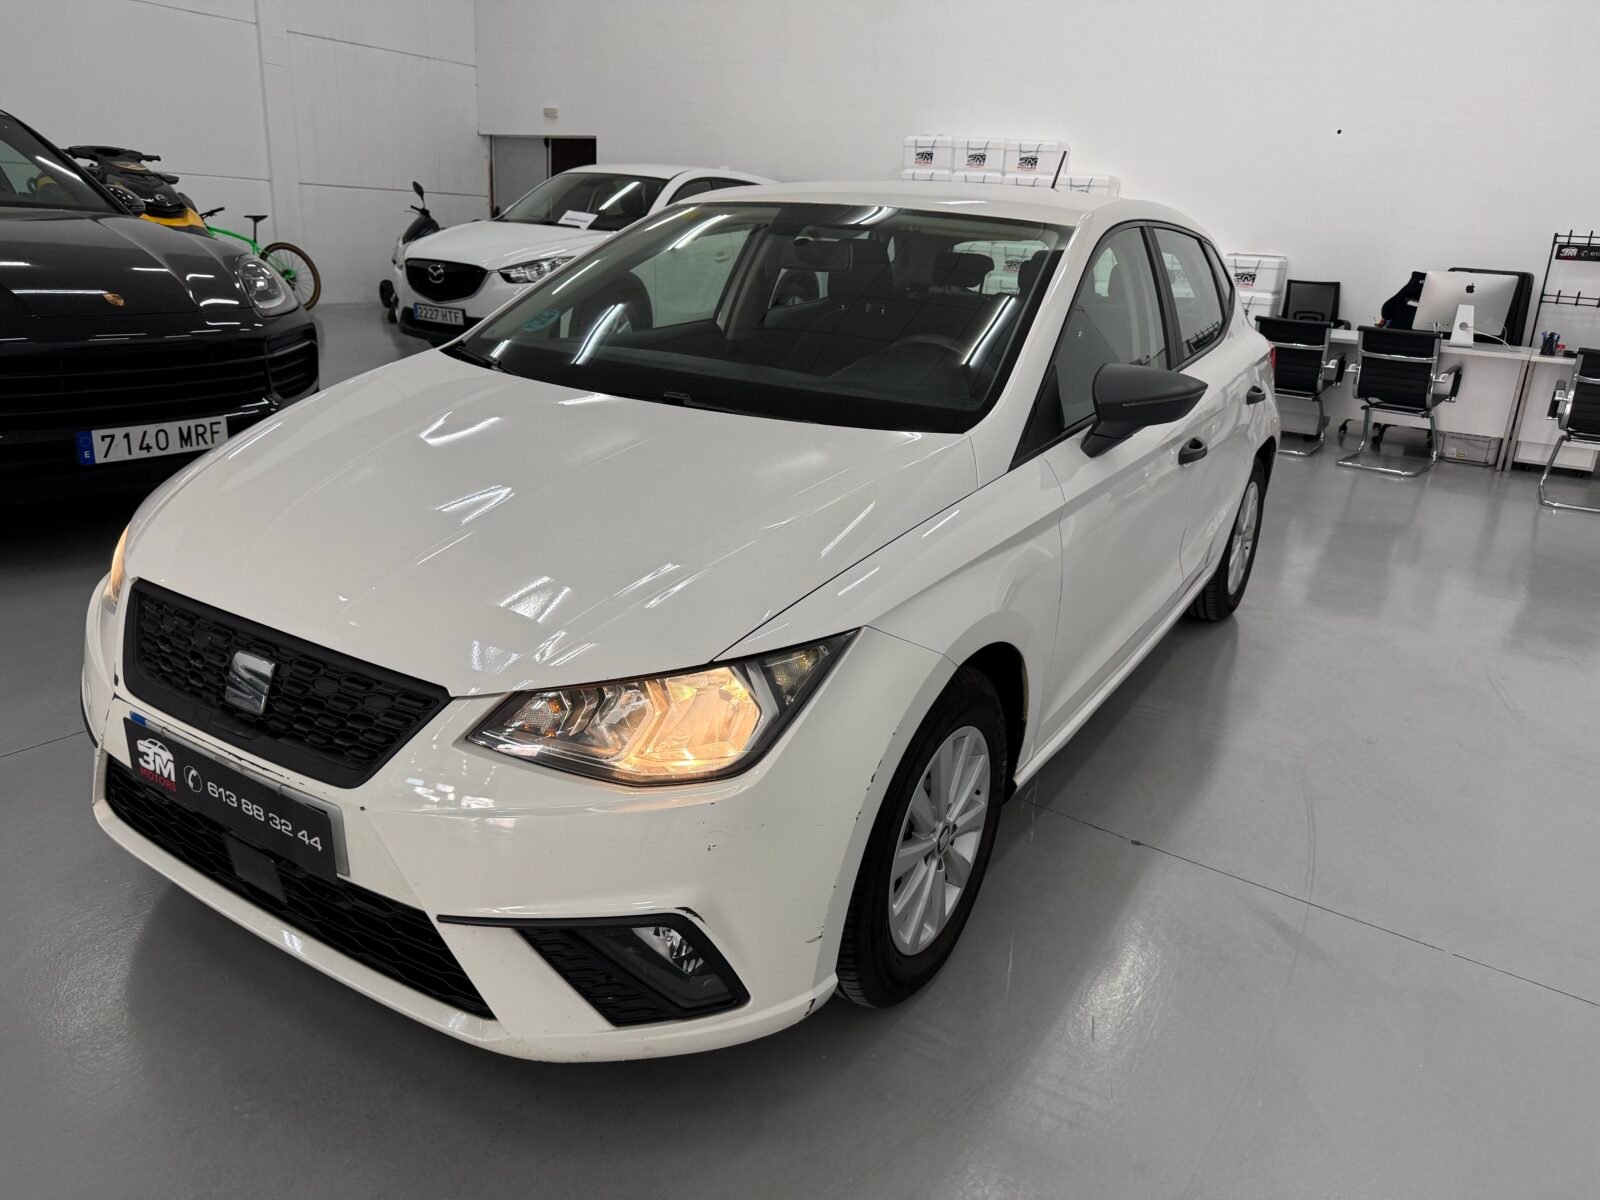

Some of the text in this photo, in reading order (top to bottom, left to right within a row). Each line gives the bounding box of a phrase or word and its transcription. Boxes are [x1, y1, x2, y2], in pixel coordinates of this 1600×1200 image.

[418, 306, 460, 323] 2227 HTF
[101, 421, 221, 458] 7140 MRF
[137, 739, 175, 782] 3M
[140, 767, 177, 792] MOTORS
[207, 781, 323, 852] 613 88 32 44
